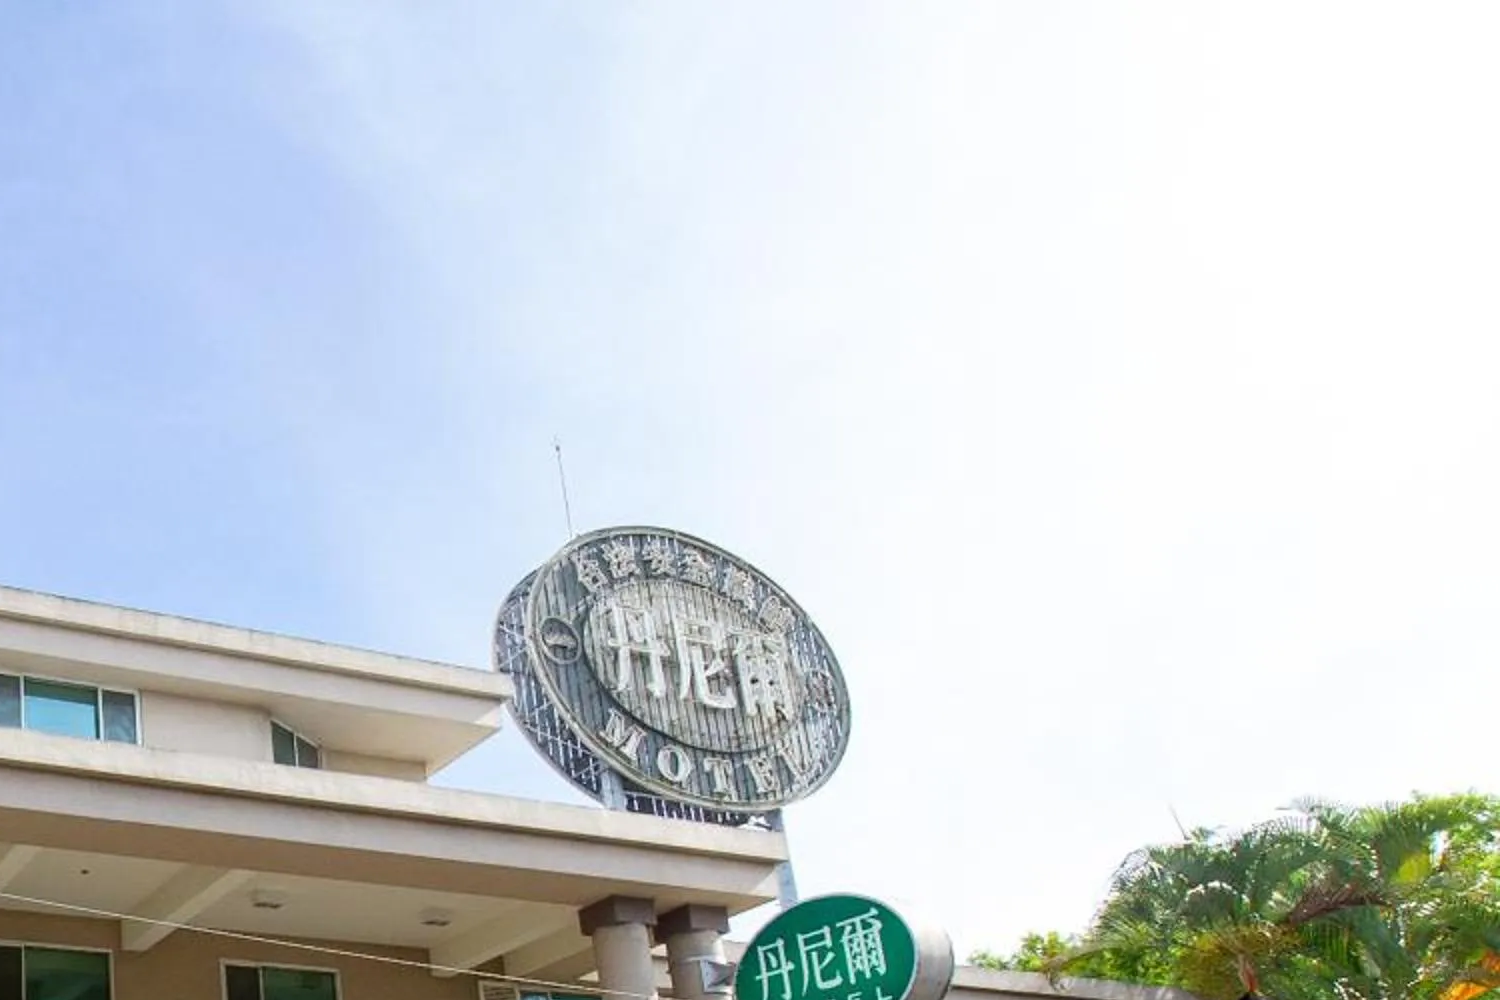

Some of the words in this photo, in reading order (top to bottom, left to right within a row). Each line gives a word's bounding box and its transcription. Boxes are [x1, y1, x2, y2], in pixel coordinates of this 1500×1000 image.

[607, 603, 794, 721] 丹尼爾
[600, 707, 822, 796] MOTEL
